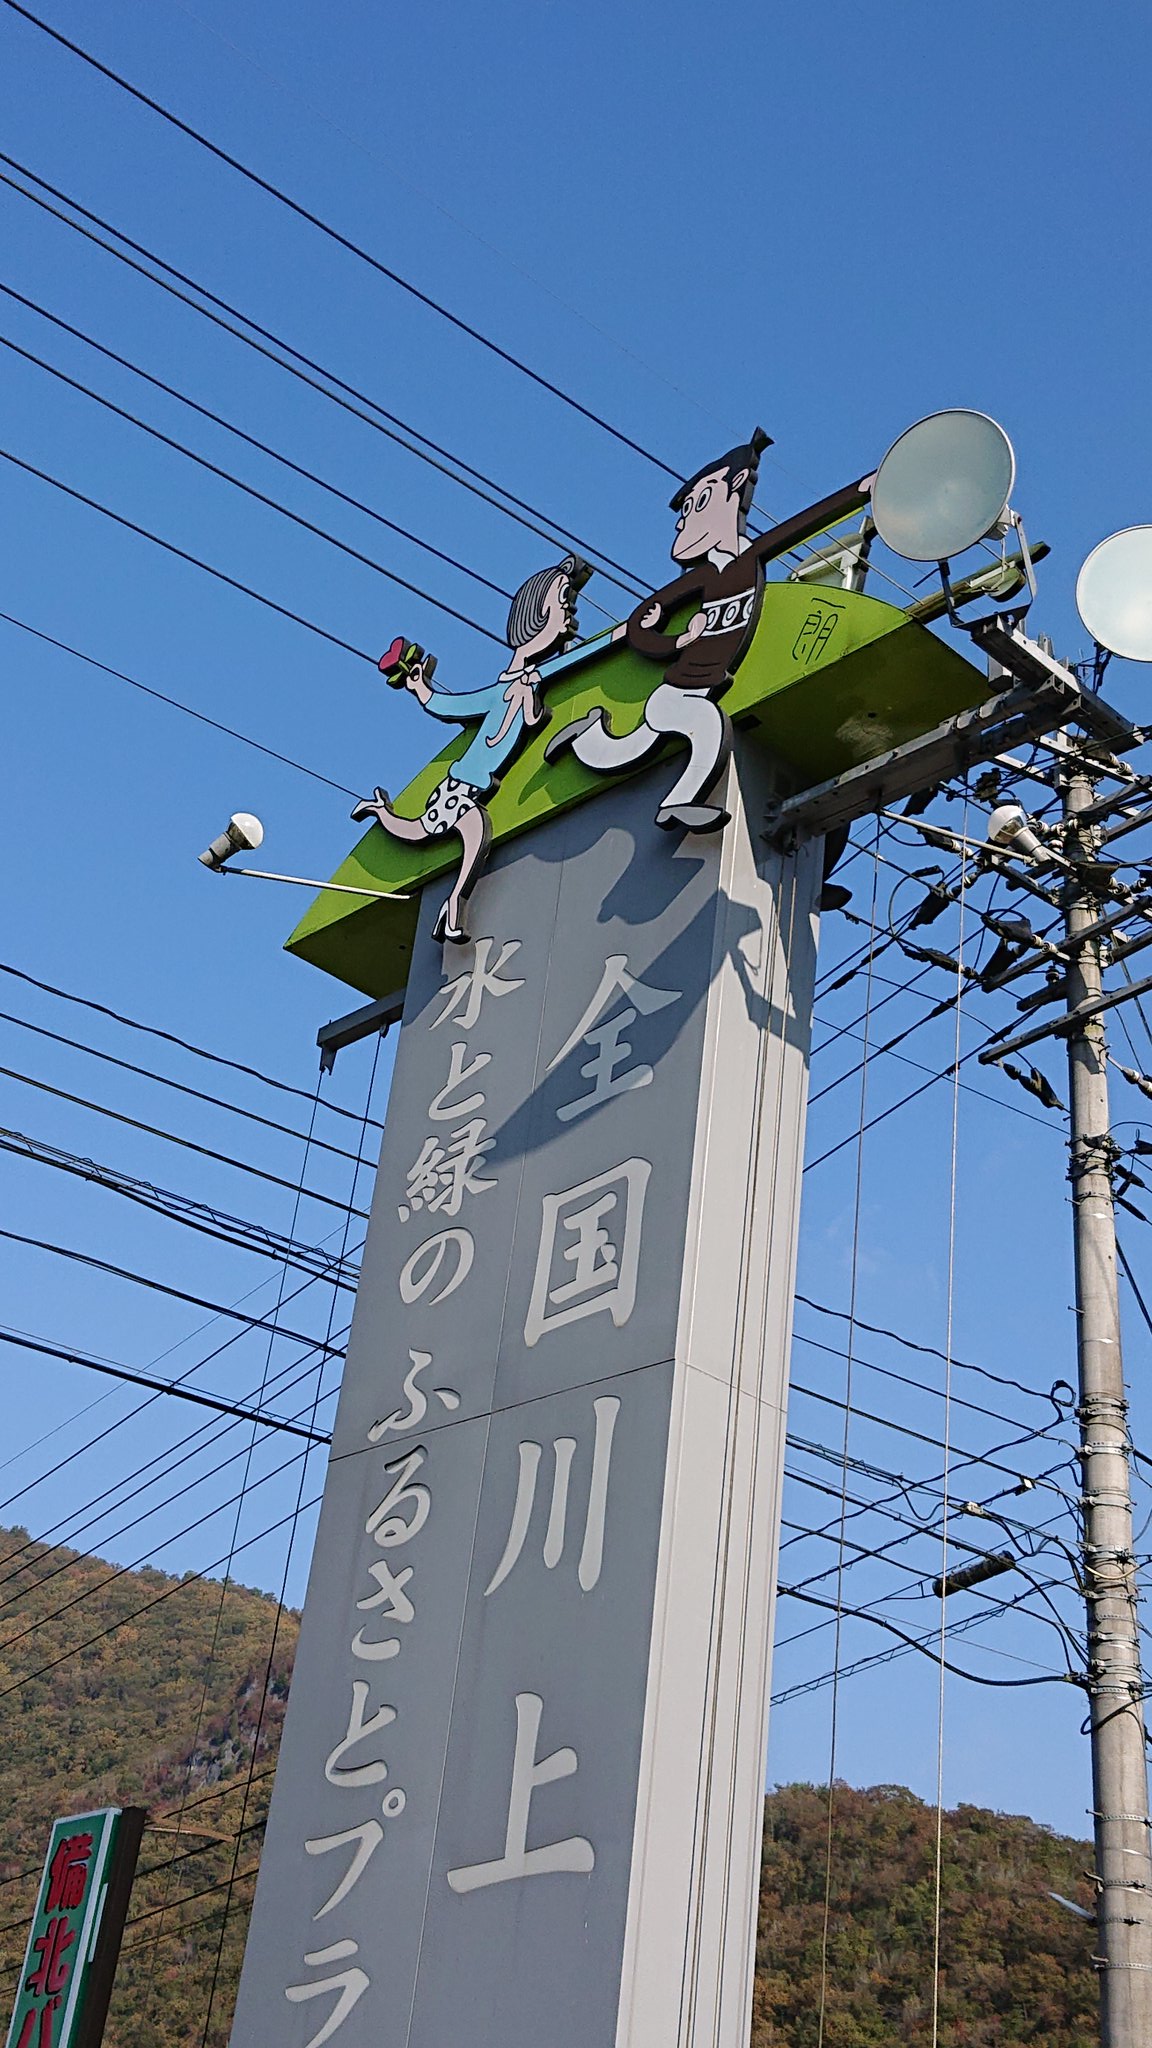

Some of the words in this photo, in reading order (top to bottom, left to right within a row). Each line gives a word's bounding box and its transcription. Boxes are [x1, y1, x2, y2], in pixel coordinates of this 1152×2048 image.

[284, 936, 526, 2048] 水と緑のふるさとプラ
[446, 954, 684, 1894] 全国川上
